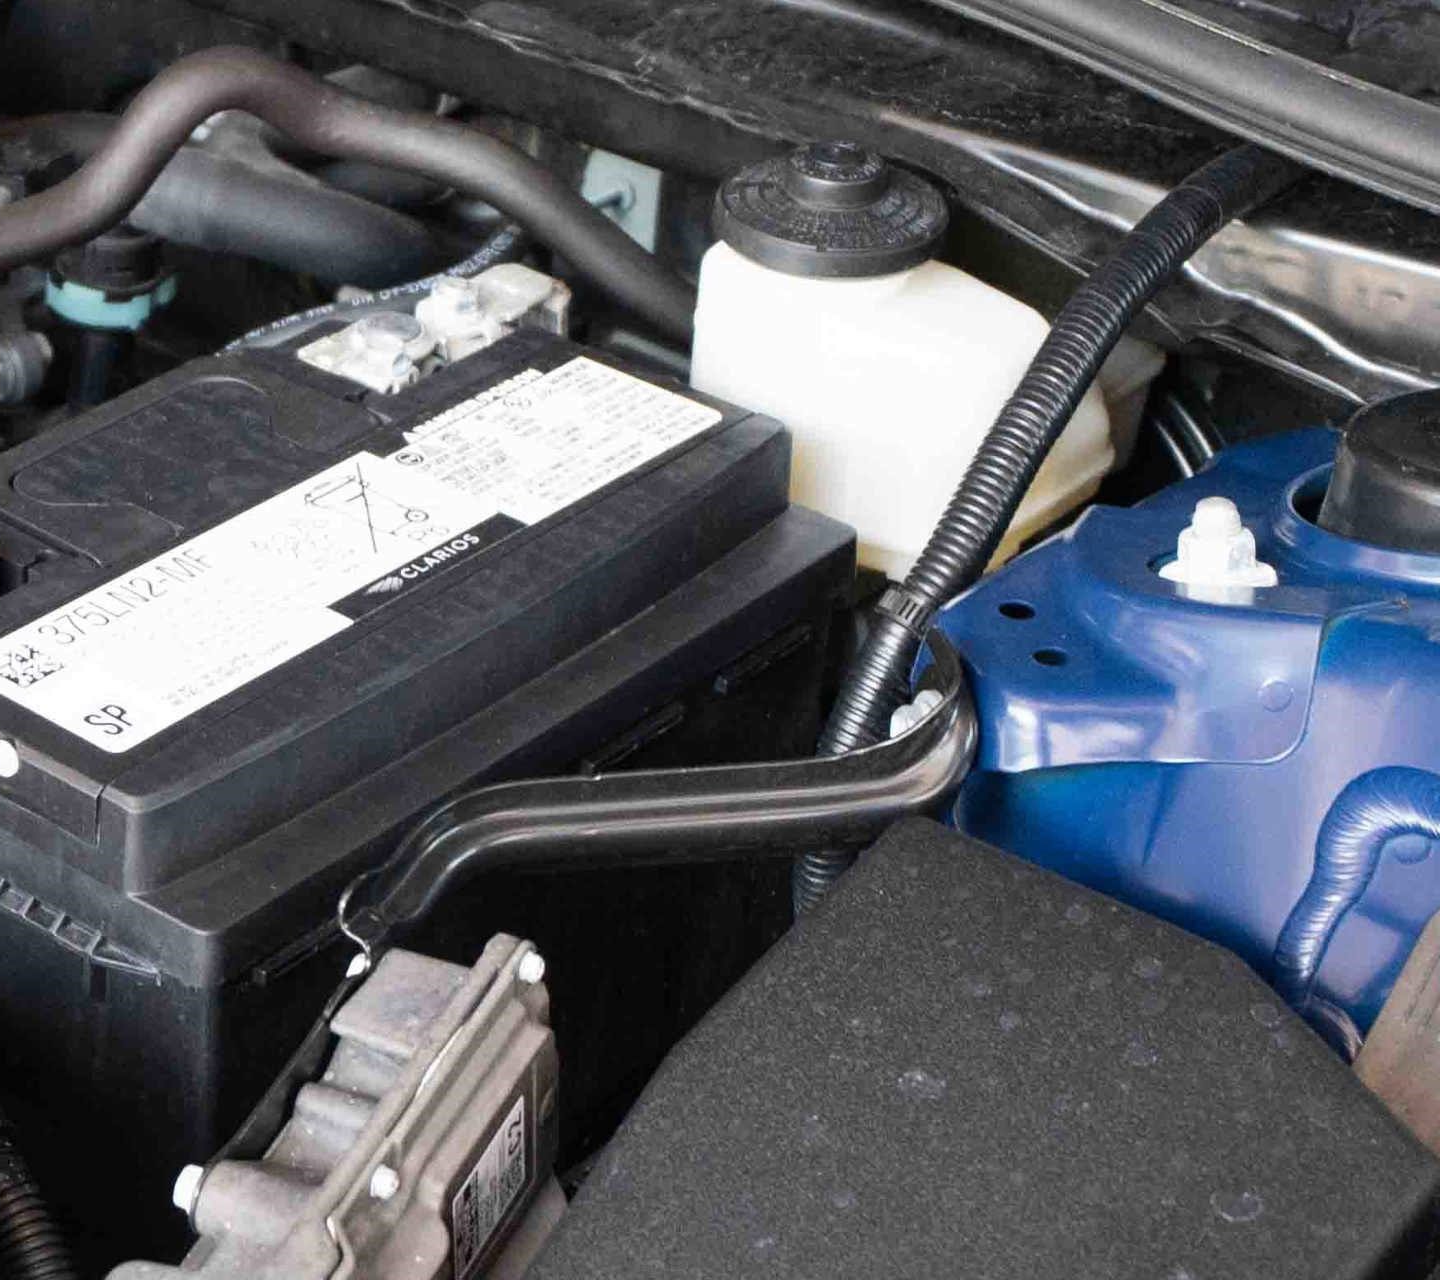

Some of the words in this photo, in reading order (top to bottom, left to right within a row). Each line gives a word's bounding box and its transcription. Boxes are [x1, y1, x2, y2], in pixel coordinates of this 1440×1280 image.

[400, 533, 480, 579] CLARIOS
[38, 547, 214, 646] 375LN2-MF
[83, 703, 133, 736] SP
